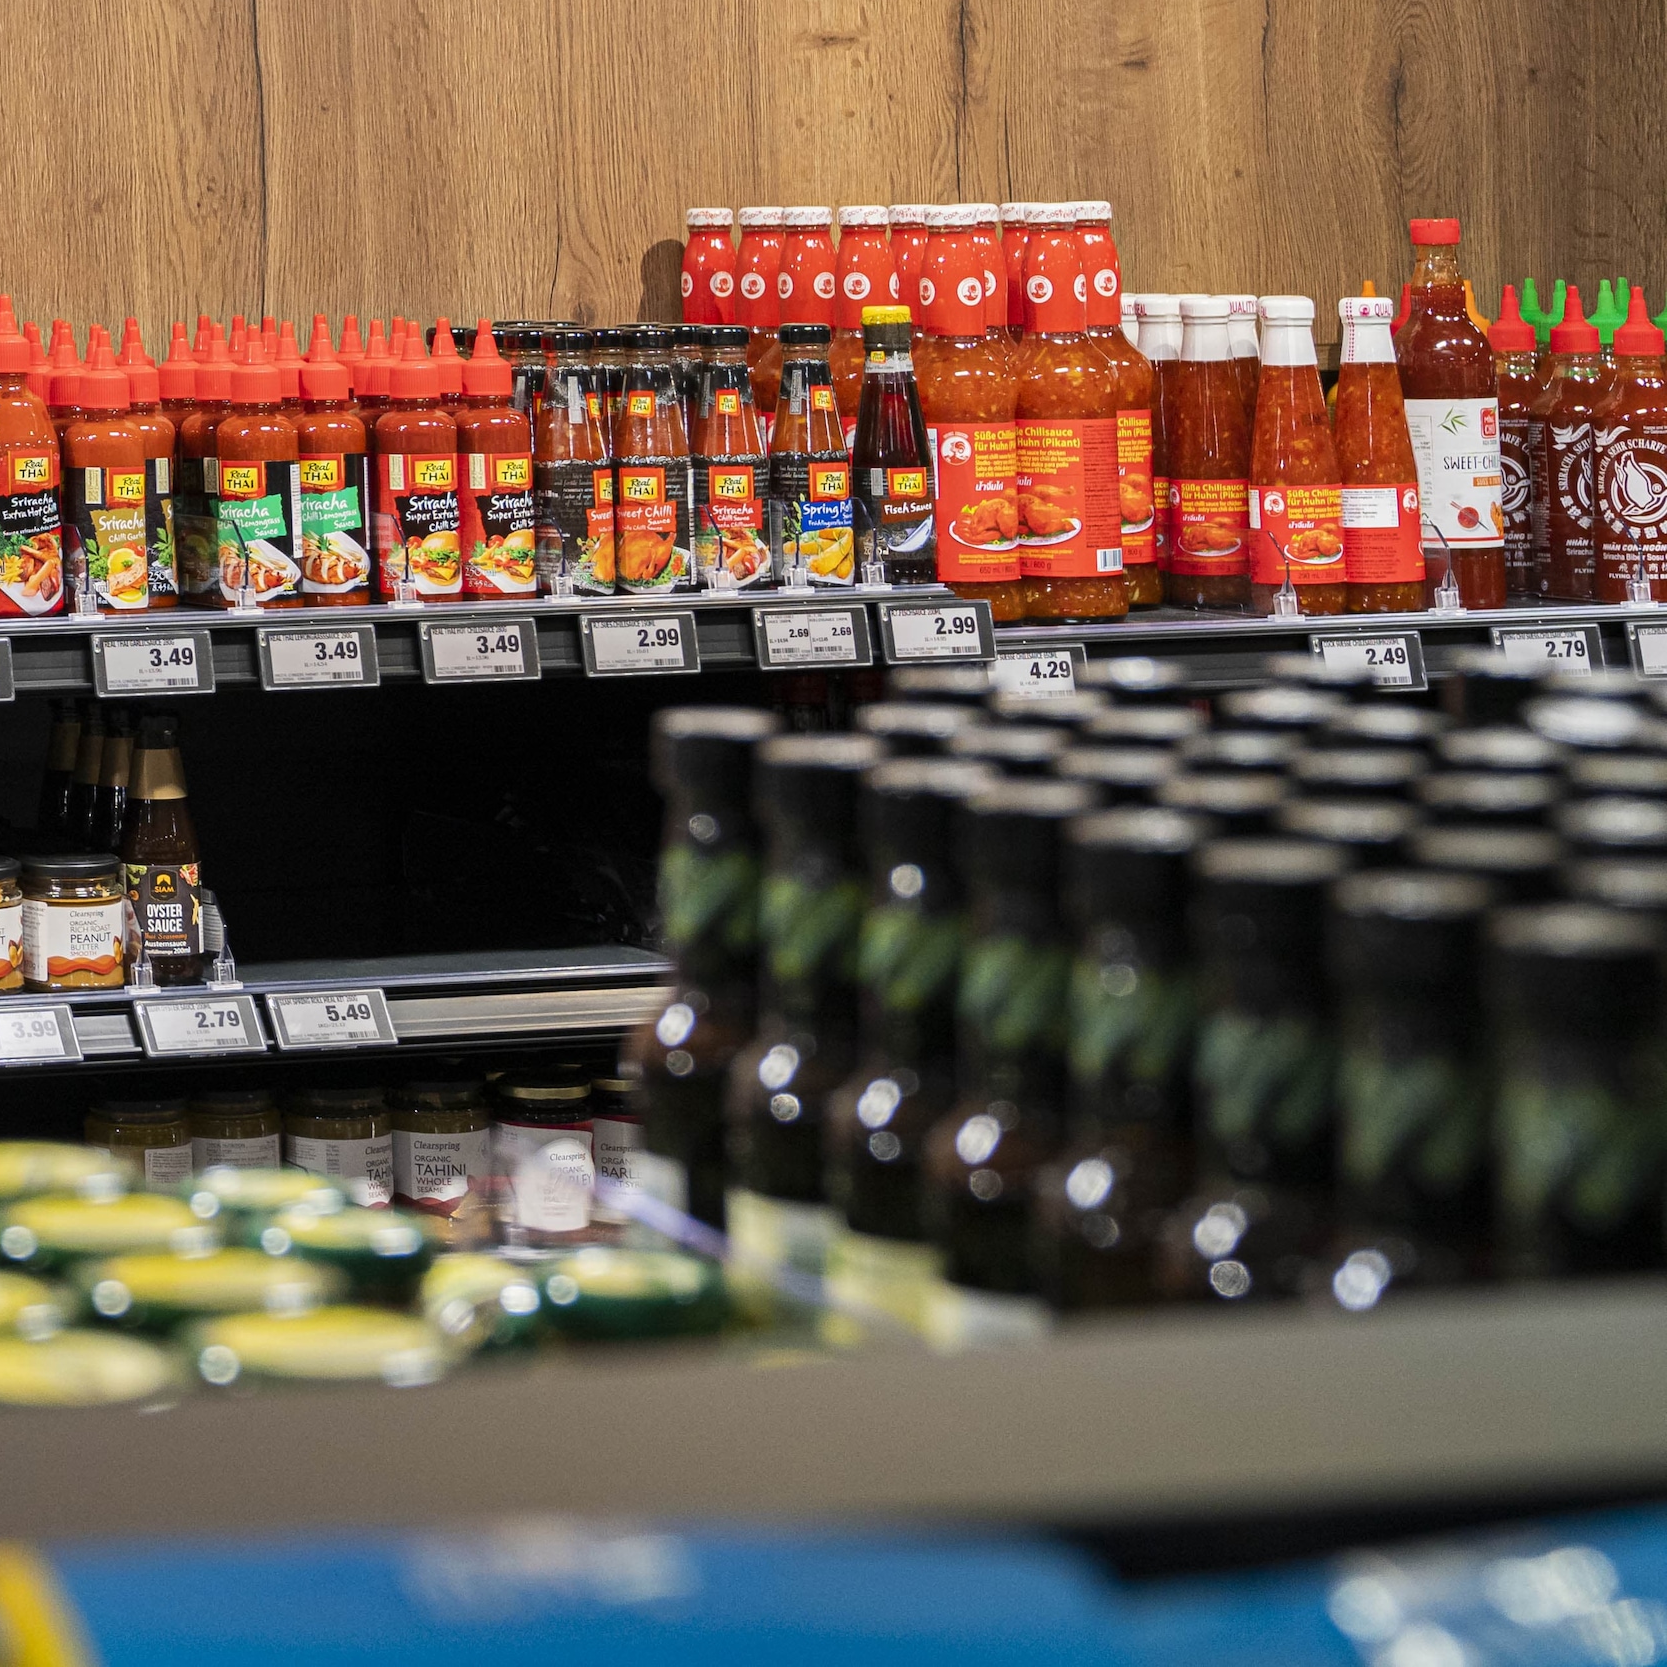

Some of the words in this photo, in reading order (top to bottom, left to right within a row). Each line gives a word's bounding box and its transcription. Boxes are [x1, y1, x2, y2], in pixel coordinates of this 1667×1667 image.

[974, 431, 996, 440] Süße
[1025, 427, 1073, 437] Chilisauce
[975, 442, 987, 450] für
[989, 442, 1007, 450] Huhn
[1018, 438, 1040, 446] Huhn
[1042, 437, 1081, 448] (Pikant)
[1599, 456, 1610, 494] SRIRACHA
[1609, 442, 1627, 457] SEHR
[1628, 439, 1666, 455] SCHARFE
[627, 486, 654, 496] THAI
[1203, 484, 1244, 492] Chilisauce
[803, 502, 839, 519] Spring
[884, 502, 909, 515] Fisch
[910, 502, 932, 514] Sauce
[831, 626, 851, 636] 2.69
[934, 616, 976, 634] 2.99
[637, 629, 679, 647] 2.99
[789, 628, 808, 637] 2.69
[315, 641, 358, 660] 3.49
[477, 635, 520, 653] 3.49
[1545, 641, 1586, 659] 2.79
[150, 648, 193, 666] 3.49
[1366, 647, 1406, 666] 2.49
[1030, 661, 1071, 678] 4.29
[147, 904, 183, 917] OYSTER
[147, 918, 183, 932] SAUCE
[71, 932, 111, 943] PEANUT
[145, 940, 187, 948] Austernsauce
[194, 1010, 241, 1028] 2.79
[325, 1003, 371, 1023] 5.49
[11, 1020, 57, 1039] 3.99
[415, 1163, 466, 1176] TAHINI
